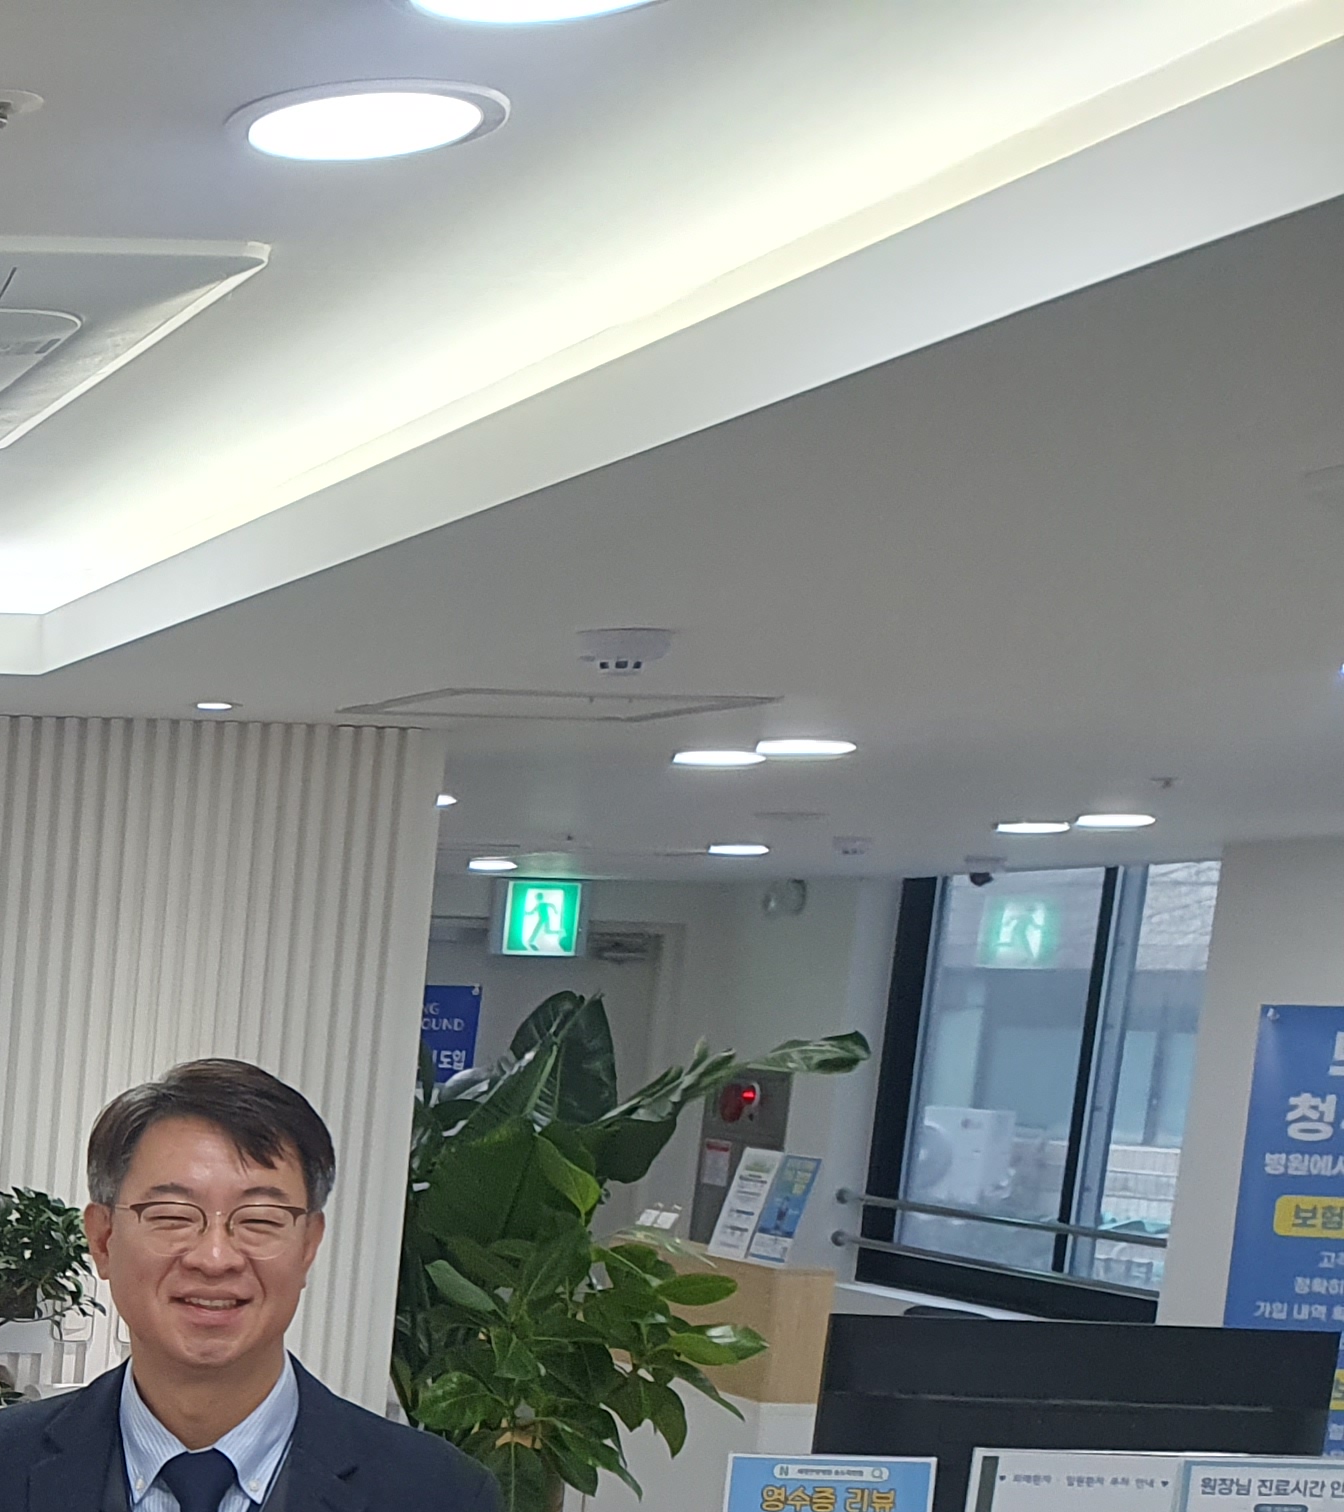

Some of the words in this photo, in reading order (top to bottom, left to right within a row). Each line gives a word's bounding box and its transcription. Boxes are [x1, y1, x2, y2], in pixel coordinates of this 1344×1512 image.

[761, 1485, 837, 1512] 영수증
[1201, 1477, 1252, 1496] 원장님
[1257, 1479, 1326, 1498] 진료시간
